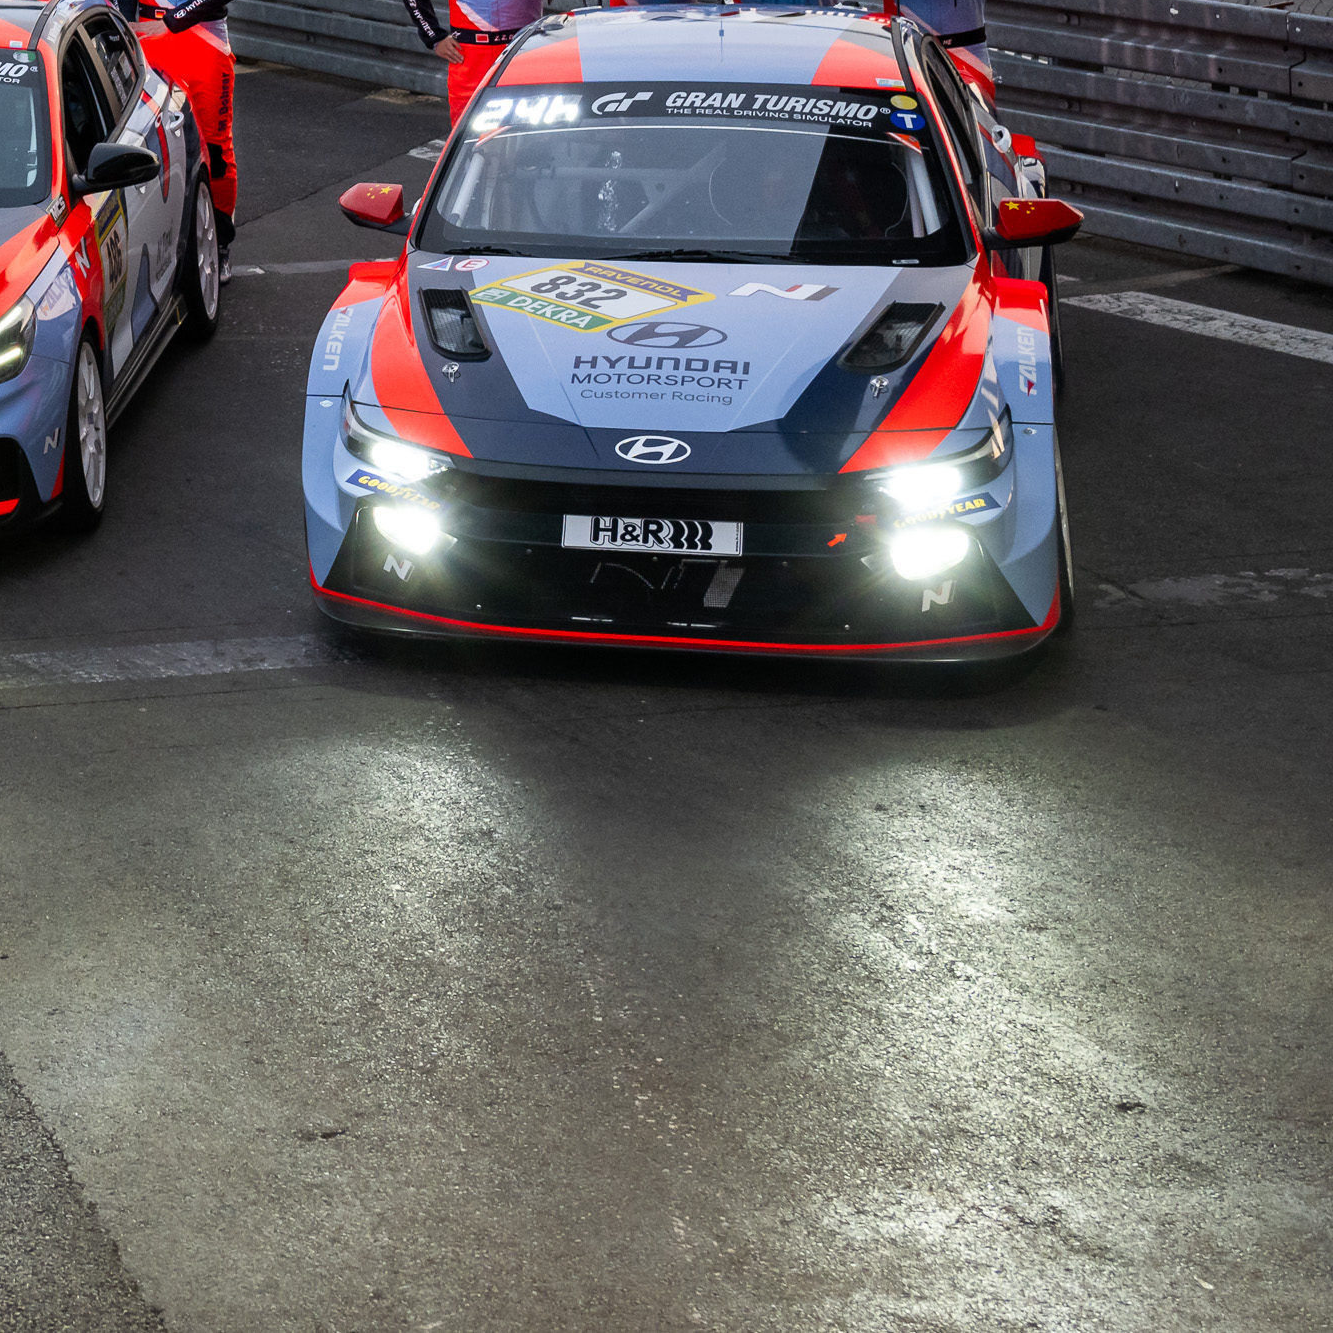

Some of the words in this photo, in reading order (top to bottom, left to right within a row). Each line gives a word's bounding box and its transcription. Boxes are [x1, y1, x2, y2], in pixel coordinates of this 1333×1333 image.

[472, 95, 580, 132] 24h
[666, 91, 749, 110] GRAN
[753, 94, 879, 120] TURISMO
[696, 108, 731, 117] REAL
[735, 110, 789, 118] DRIVING
[794, 114, 872, 128] SIMULATOR
[902, 114, 921, 128] T
[531, 275, 629, 309] 832
[585, 265, 683, 297] RAVENOL
[507, 296, 592, 329] DEKRA
[323, 306, 354, 371] FALKEN
[573, 355, 750, 375] HYUNDAI
[1018, 326, 1037, 397] FALKEN
[571, 373, 749, 390] MOTORSPORT
[581, 389, 665, 401] Customer
[671, 391, 733, 405] Racing
[358, 475, 441, 511] GOODYEAR
[591, 516, 666, 546] H&R
